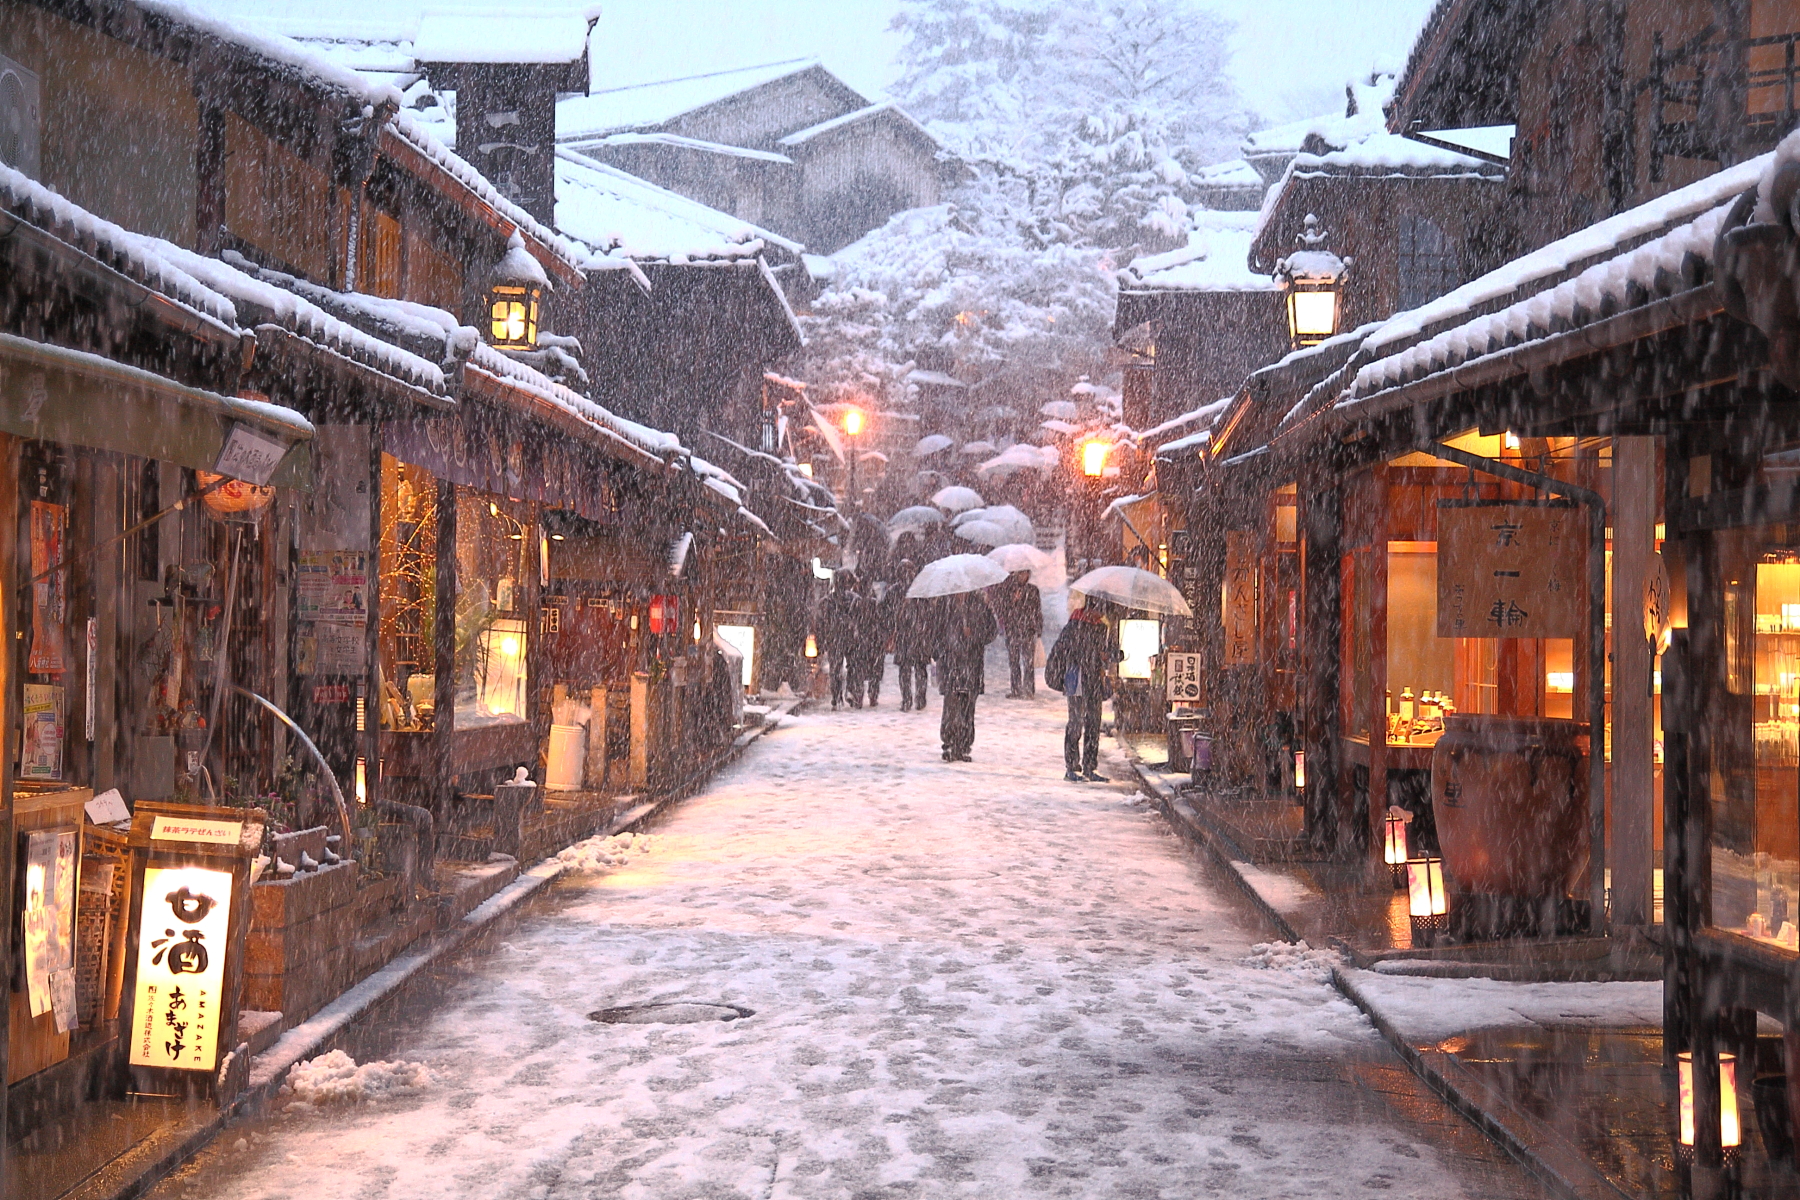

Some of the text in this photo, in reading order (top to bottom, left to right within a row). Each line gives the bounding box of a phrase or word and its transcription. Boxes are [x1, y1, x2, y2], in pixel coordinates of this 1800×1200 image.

[1487, 519, 1528, 628] 京一輪
[162, 825, 232, 837] 抹茶ラテぜんざい
[151, 885, 218, 975] 甘酒
[165, 985, 189, 1061] あまざけ
[193, 990, 207, 1062] AMAZAKE
